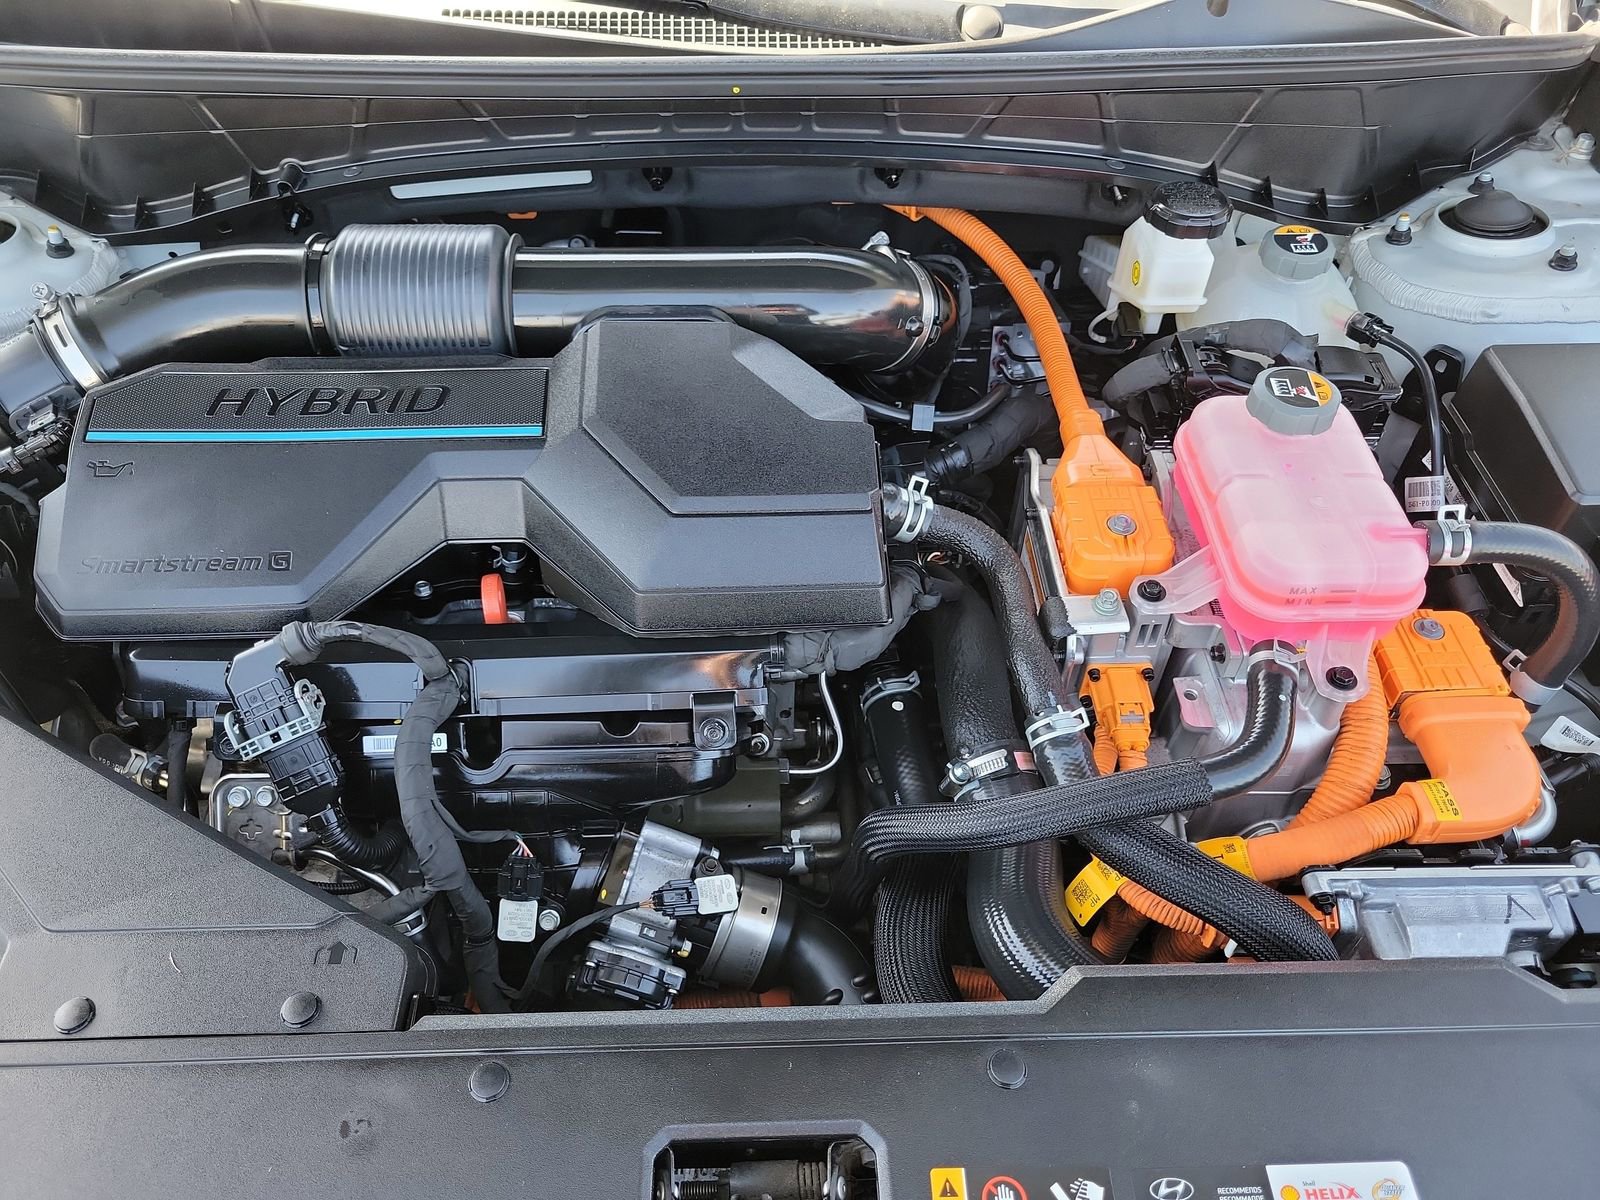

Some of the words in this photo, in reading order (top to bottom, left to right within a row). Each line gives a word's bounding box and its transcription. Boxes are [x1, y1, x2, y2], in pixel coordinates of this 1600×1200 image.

[205, 384, 450, 417] HYBRID
[77, 553, 264, 575] Smartstream
[1288, 586, 1318, 595] MAX
[1284, 597, 1313, 606] MIN
[1437, 781, 1460, 816] PASS
[1090, 893, 1101, 907] MP
[1217, 1186, 1263, 1195] RECOMMENDS
[1304, 1187, 1360, 1200] HELIX
